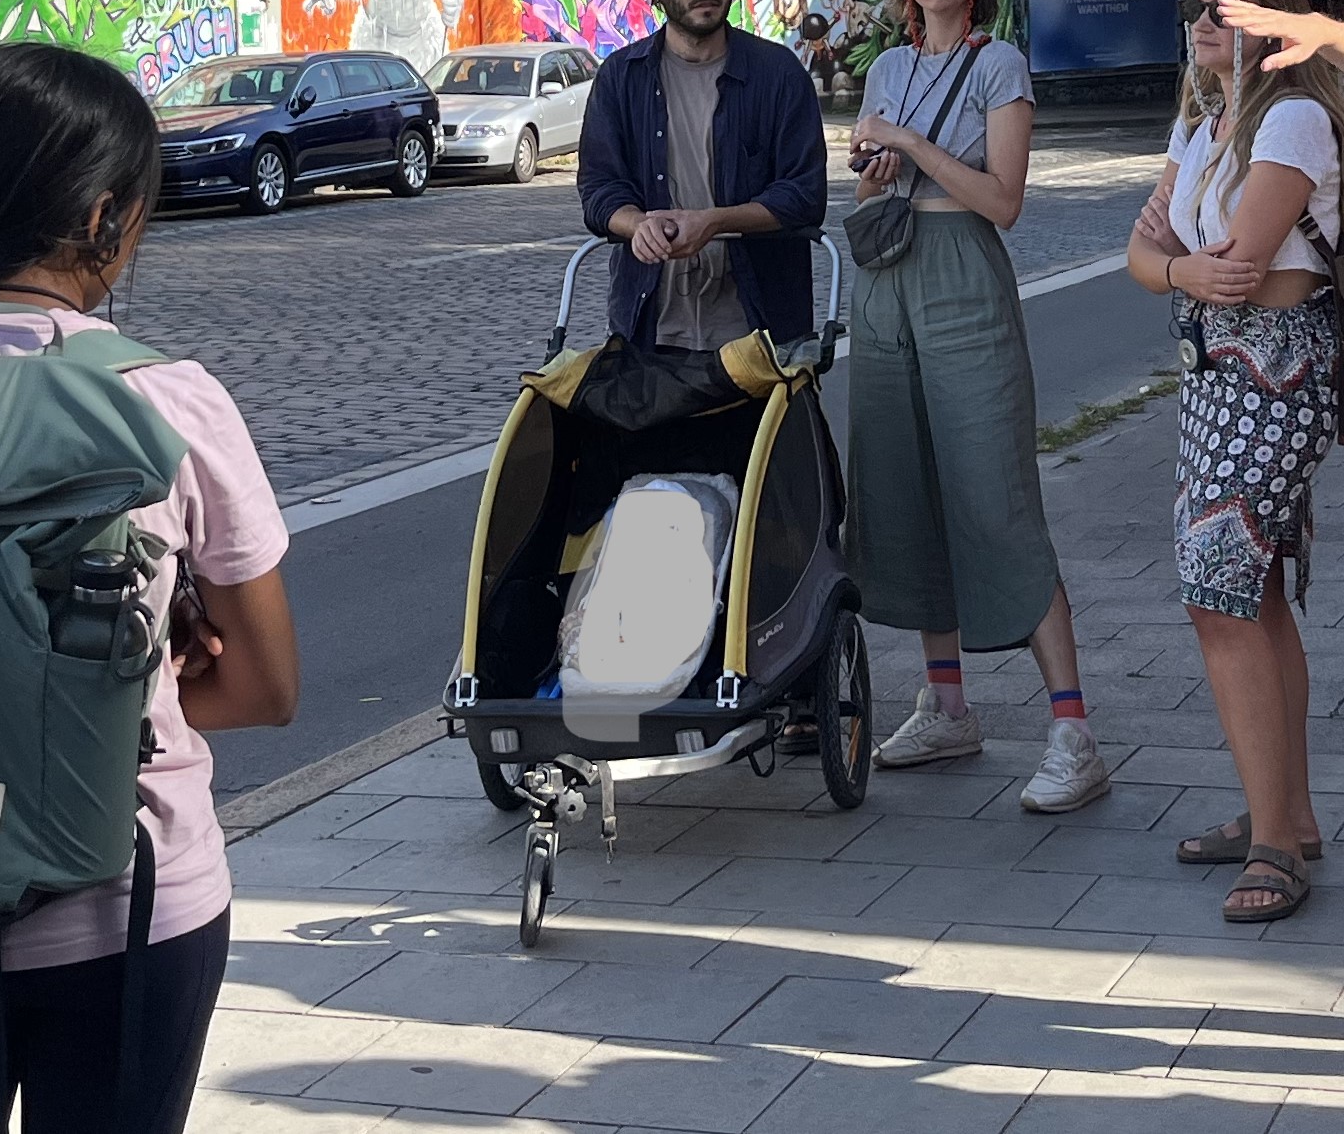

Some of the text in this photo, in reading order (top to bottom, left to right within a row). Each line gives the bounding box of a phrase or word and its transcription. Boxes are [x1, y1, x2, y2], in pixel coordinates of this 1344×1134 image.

[1077, 3, 1129, 14] WANT THEM
[136, 6, 238, 97] BRUCH
